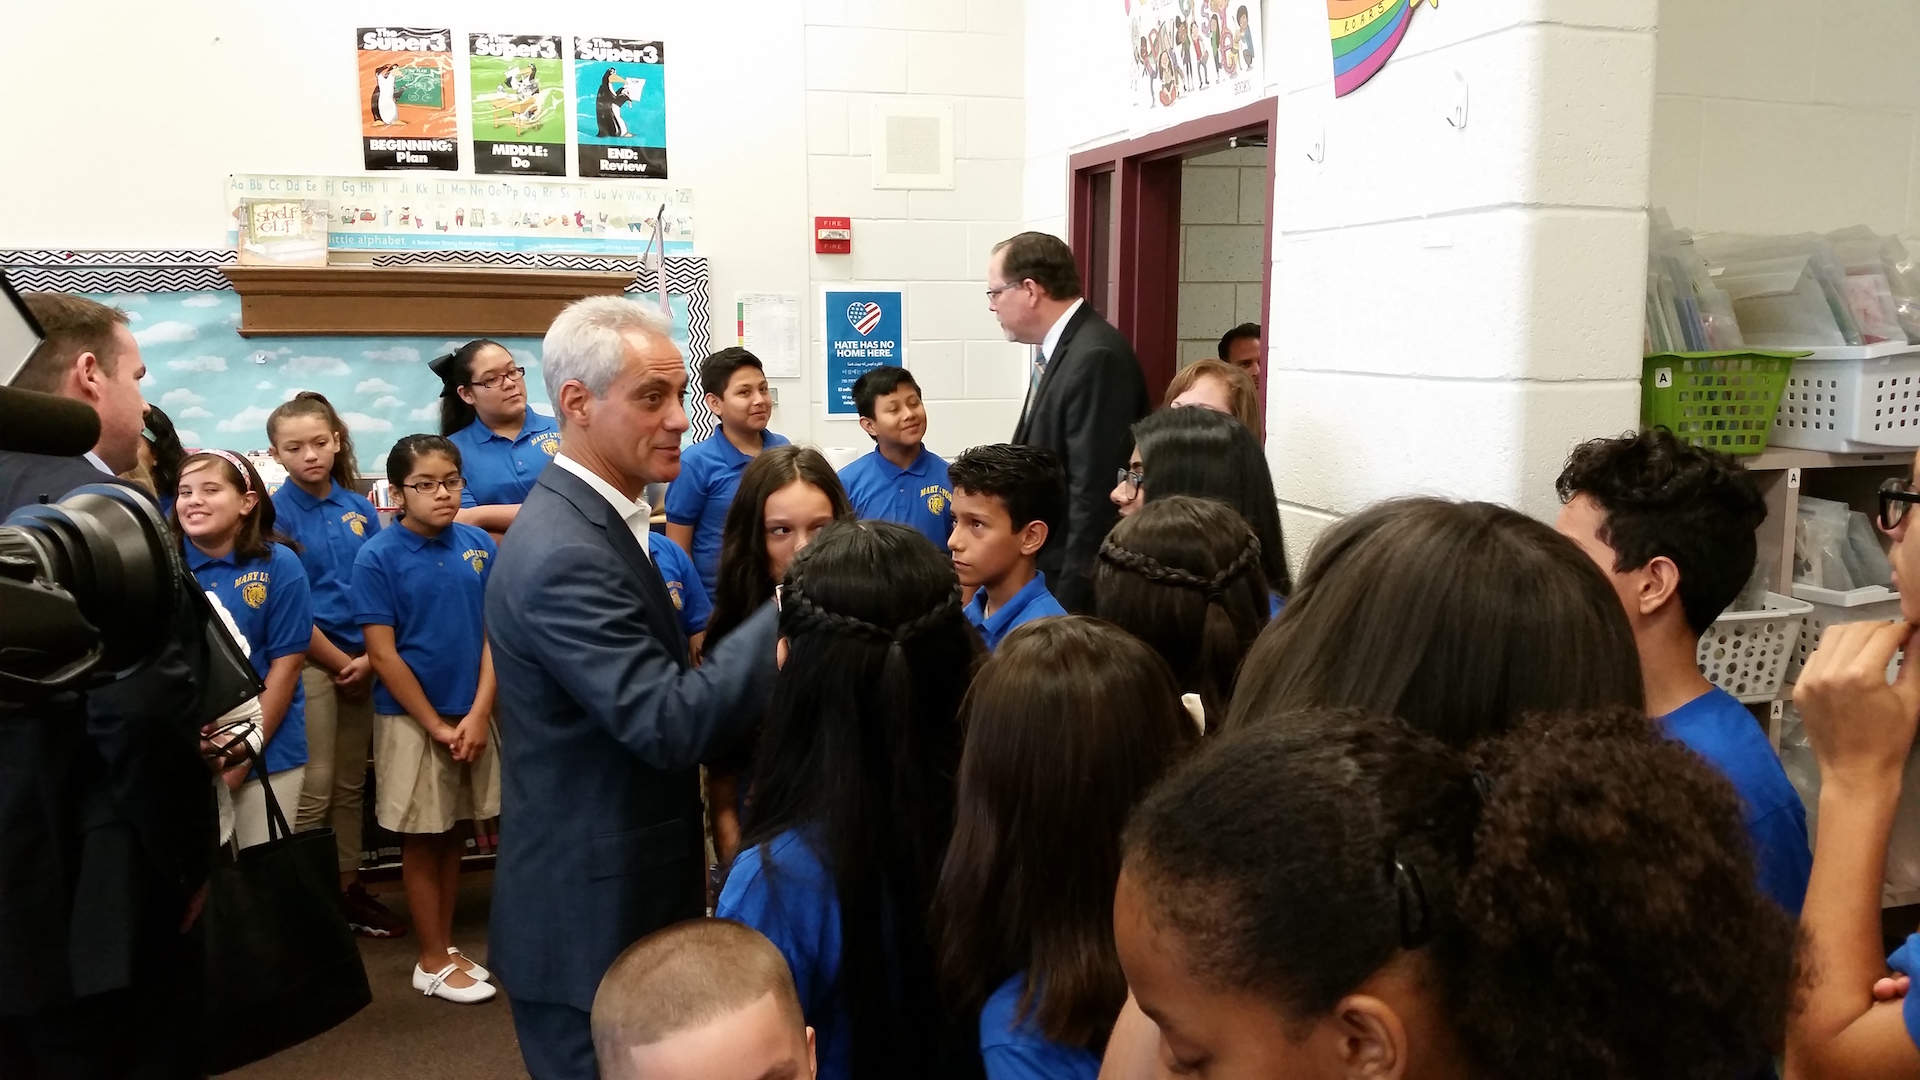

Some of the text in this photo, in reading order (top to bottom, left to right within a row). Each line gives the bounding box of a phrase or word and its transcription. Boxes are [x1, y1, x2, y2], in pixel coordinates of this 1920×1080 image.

[375, 28, 397, 38] The
[591, 37, 613, 48] The
[369, 138, 453, 151] BEGINNING:
[492, 144, 548, 157] MIDDLE:
[396, 151, 428, 163] Plan
[607, 147, 638, 160] END:
[511, 156, 530, 168] Do
[599, 159, 647, 172] Review
[230, 178, 244, 190] Aa
[249, 179, 262, 190] Bb
[269, 179, 280, 191] Cc
[286, 179, 300, 191] Dd
[306, 180, 317, 192] Ee
[325, 180, 335, 196] Ff
[341, 180, 355, 196] Gg
[360, 181, 374, 193] Hh
[416, 183, 428, 195] Kk
[451, 184, 466, 195] Mm
[470, 184, 484, 196] Nn
[488, 185, 501, 196] Oo
[506, 185, 519, 200] Pp
[523, 186, 537, 200] Qq
[578, 188, 587, 199] Tt
[594, 189, 606, 200] Uu
[611, 189, 623, 200] Vv
[626, 190, 641, 201] Ww
[646, 190, 657, 202] Xx
[662, 192, 673, 206] Yy
[679, 192, 690, 203] Zz
[328, 234, 406, 247] little alphabet
[834, 340, 895, 349] HATE HAS NO
[836, 349, 893, 357] HOME HERE.
[1659, 372, 1668, 383] A
[531, 433, 548, 446] MARY
[1790, 473, 1797, 483] A
[920, 485, 939, 498] MARY
[234, 571, 259, 588] MARY
[1773, 705, 1779, 715] A
